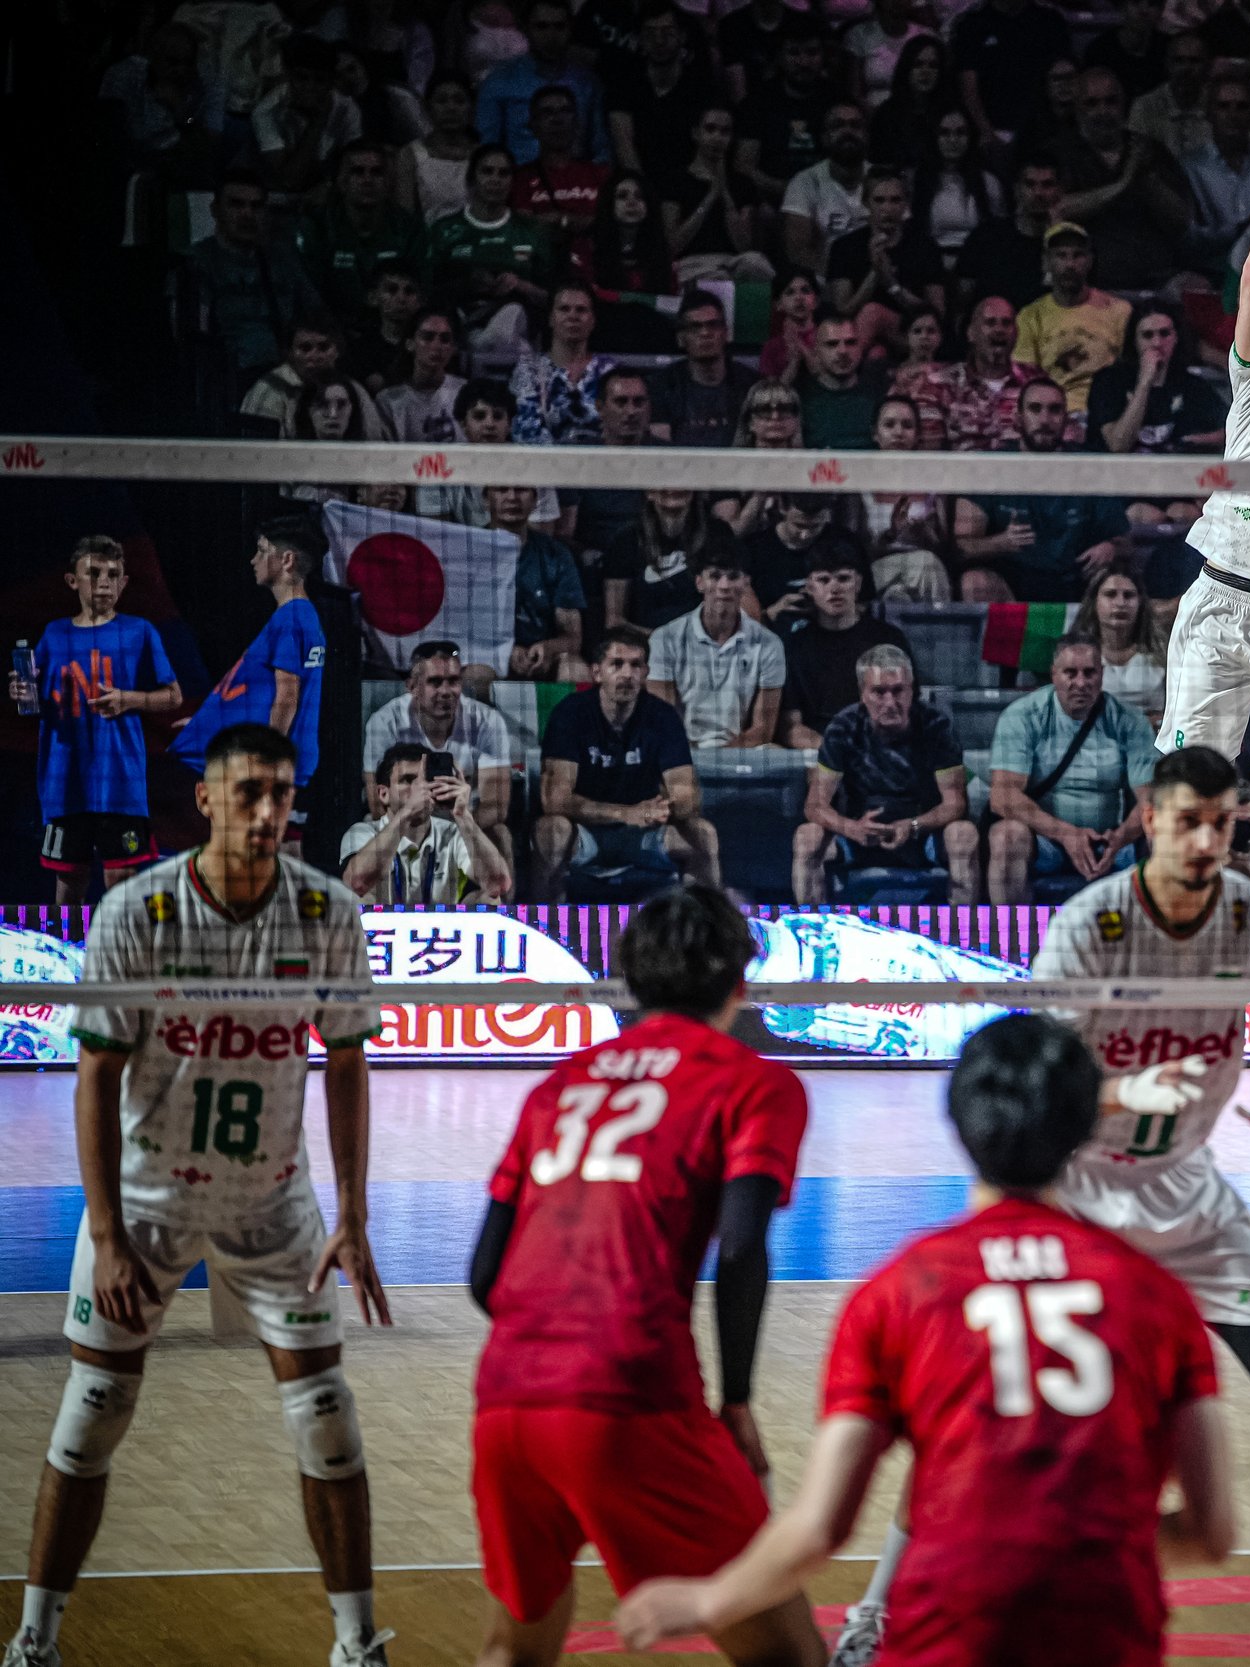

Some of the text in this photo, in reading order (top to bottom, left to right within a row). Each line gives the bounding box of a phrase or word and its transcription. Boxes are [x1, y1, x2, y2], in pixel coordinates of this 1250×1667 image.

[2, 443, 45, 470] VNL
[412, 451, 455, 479] VNL
[41, 823, 65, 860] 11
[160, 1014, 310, 1061] efbet
[190, 1077, 265, 1155] 18
[530, 1080, 669, 1186] 32
[73, 1295, 92, 1325] 18
[962, 1280, 1115, 1417] 15
